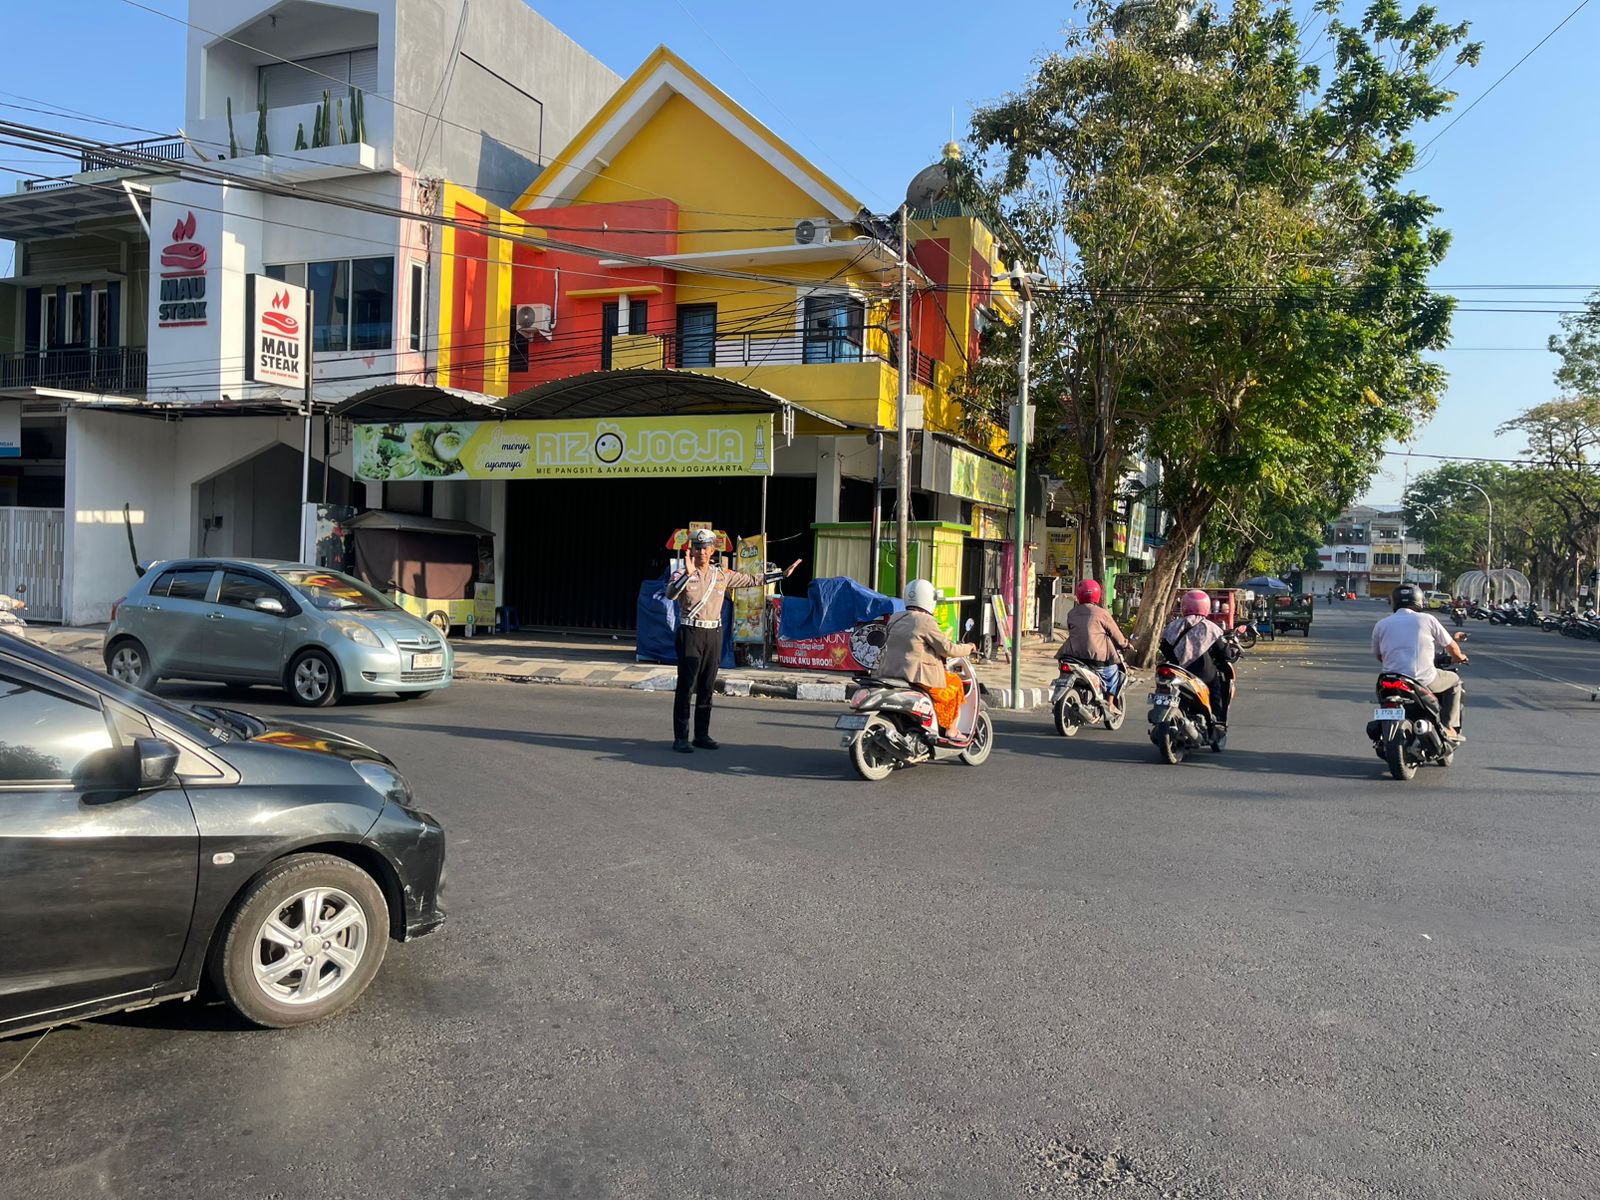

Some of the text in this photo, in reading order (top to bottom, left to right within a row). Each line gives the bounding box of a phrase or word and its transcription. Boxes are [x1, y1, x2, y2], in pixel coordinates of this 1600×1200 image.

[160, 277, 206, 301] MAU
[159, 302, 207, 320] STEAK
[262, 337, 299, 359] MAU
[261, 354, 299, 373] STEAK
[501, 442, 531, 454] mienya
[624, 428, 744, 464] JOGJA
[484, 461, 522, 472] ayamnya
[681, 465, 743, 473] JOGJAKARTA
[779, 655, 798, 664] TUSUK
[798, 657, 811, 665] AKU
